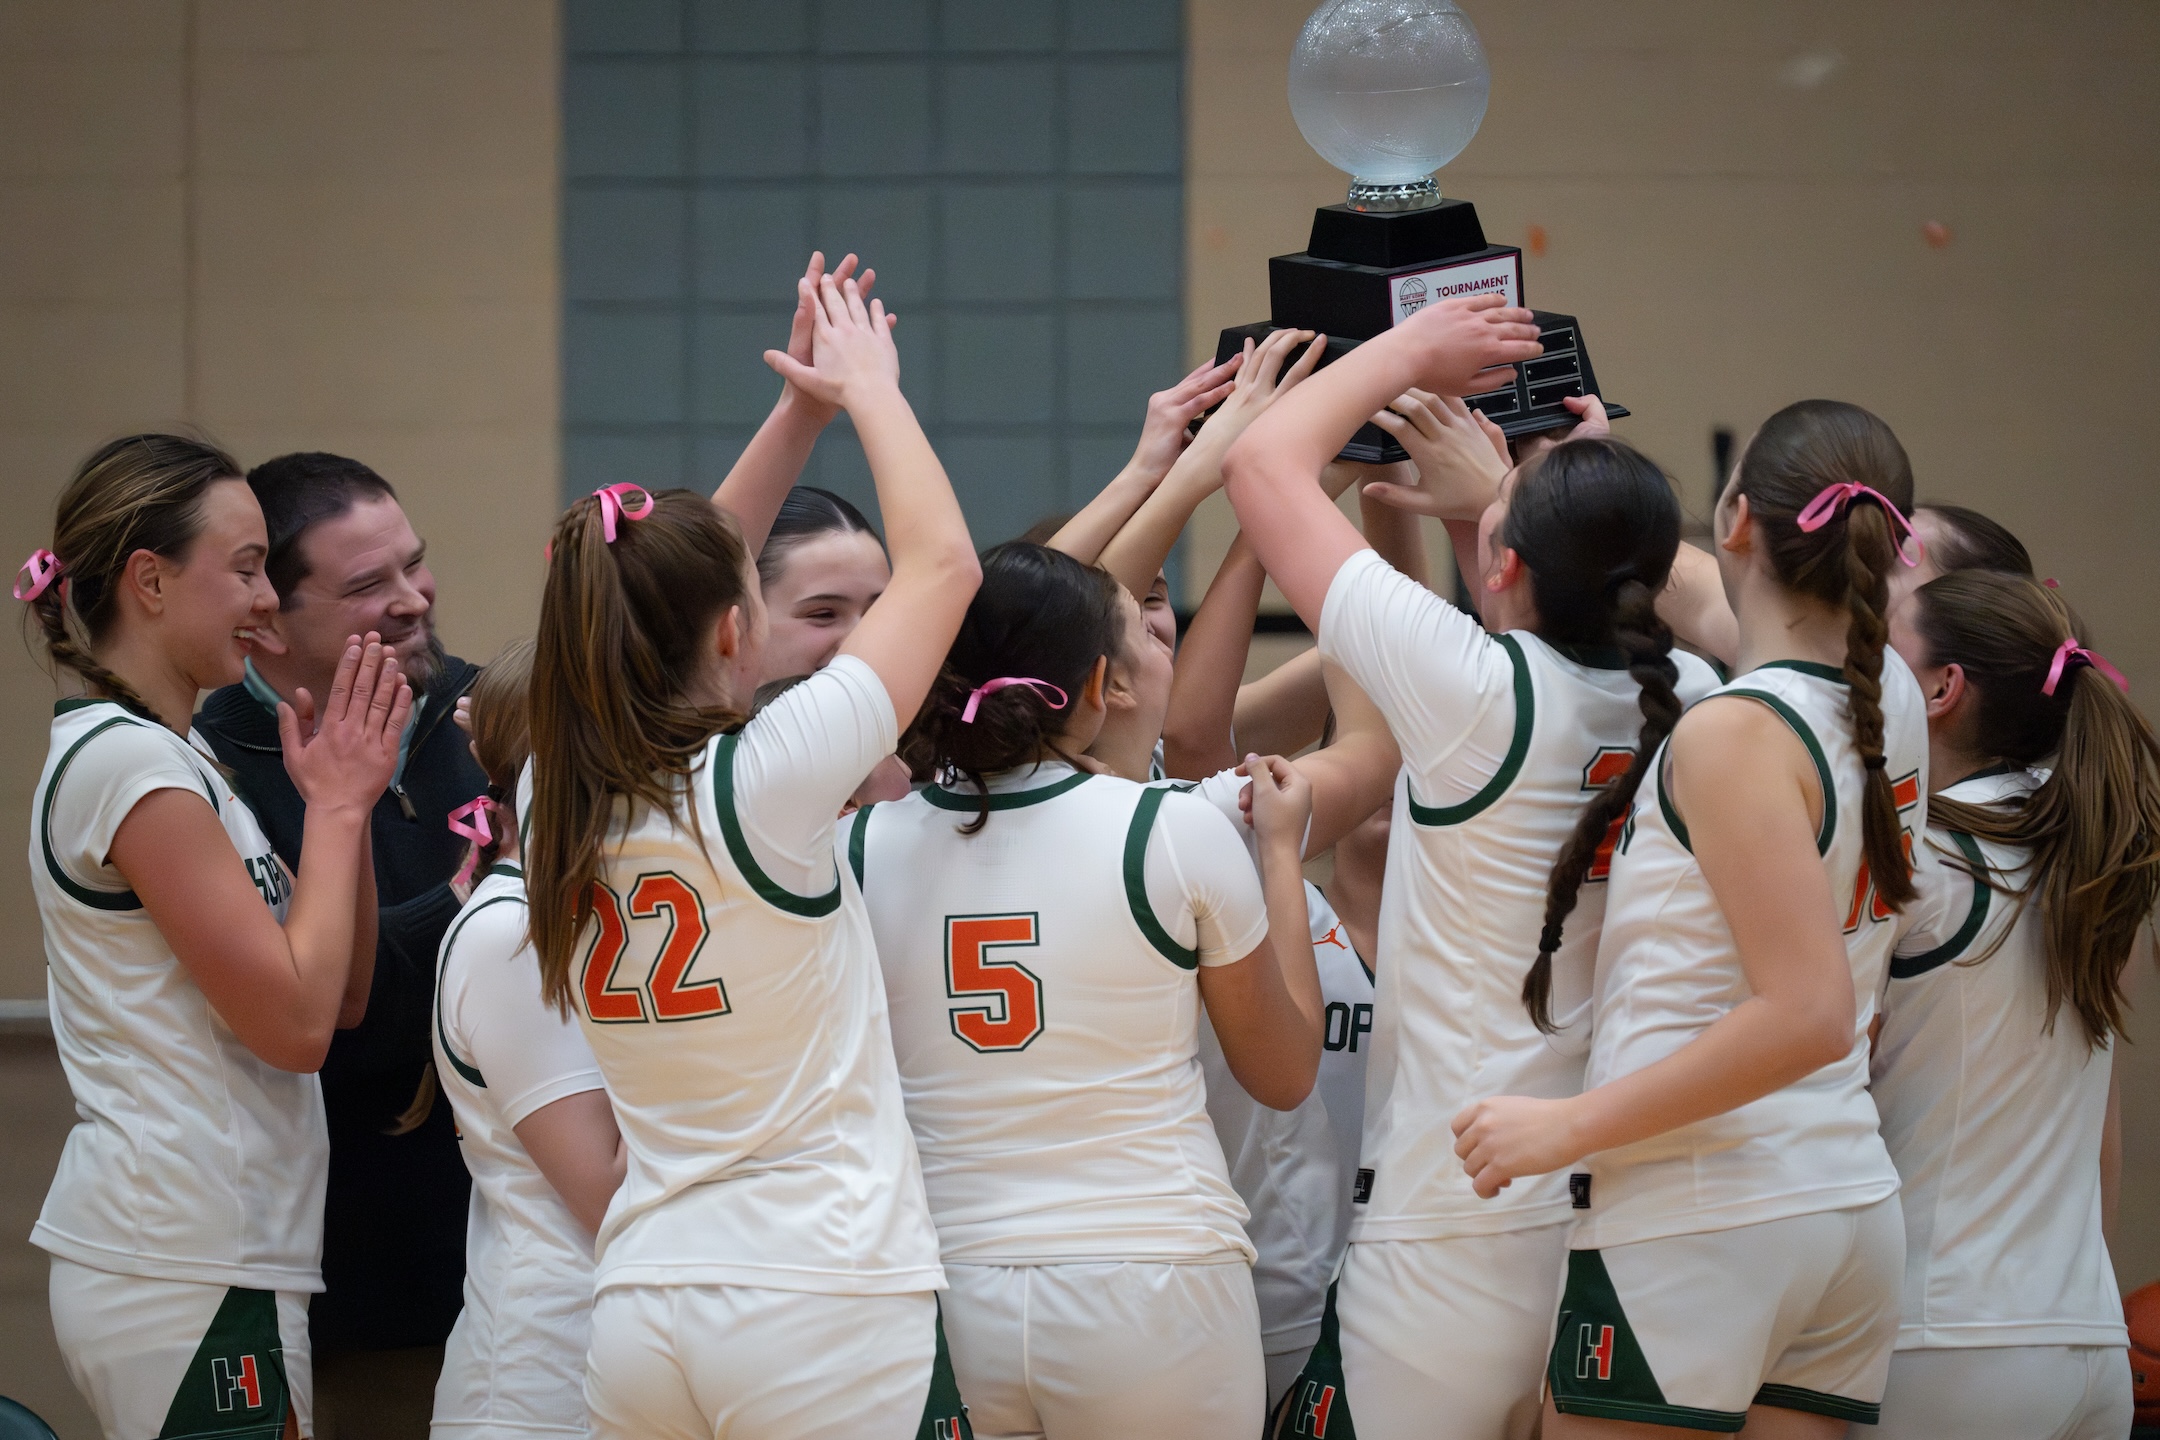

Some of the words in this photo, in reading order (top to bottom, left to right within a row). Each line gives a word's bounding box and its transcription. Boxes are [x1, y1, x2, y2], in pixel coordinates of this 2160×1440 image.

[1436, 275, 1509, 298] TOURNAMENT
[571, 870, 732, 1024] 22
[943, 911, 1045, 1054] 5
[1576, 1323, 1614, 1380] H
[211, 1354, 262, 1412] H
